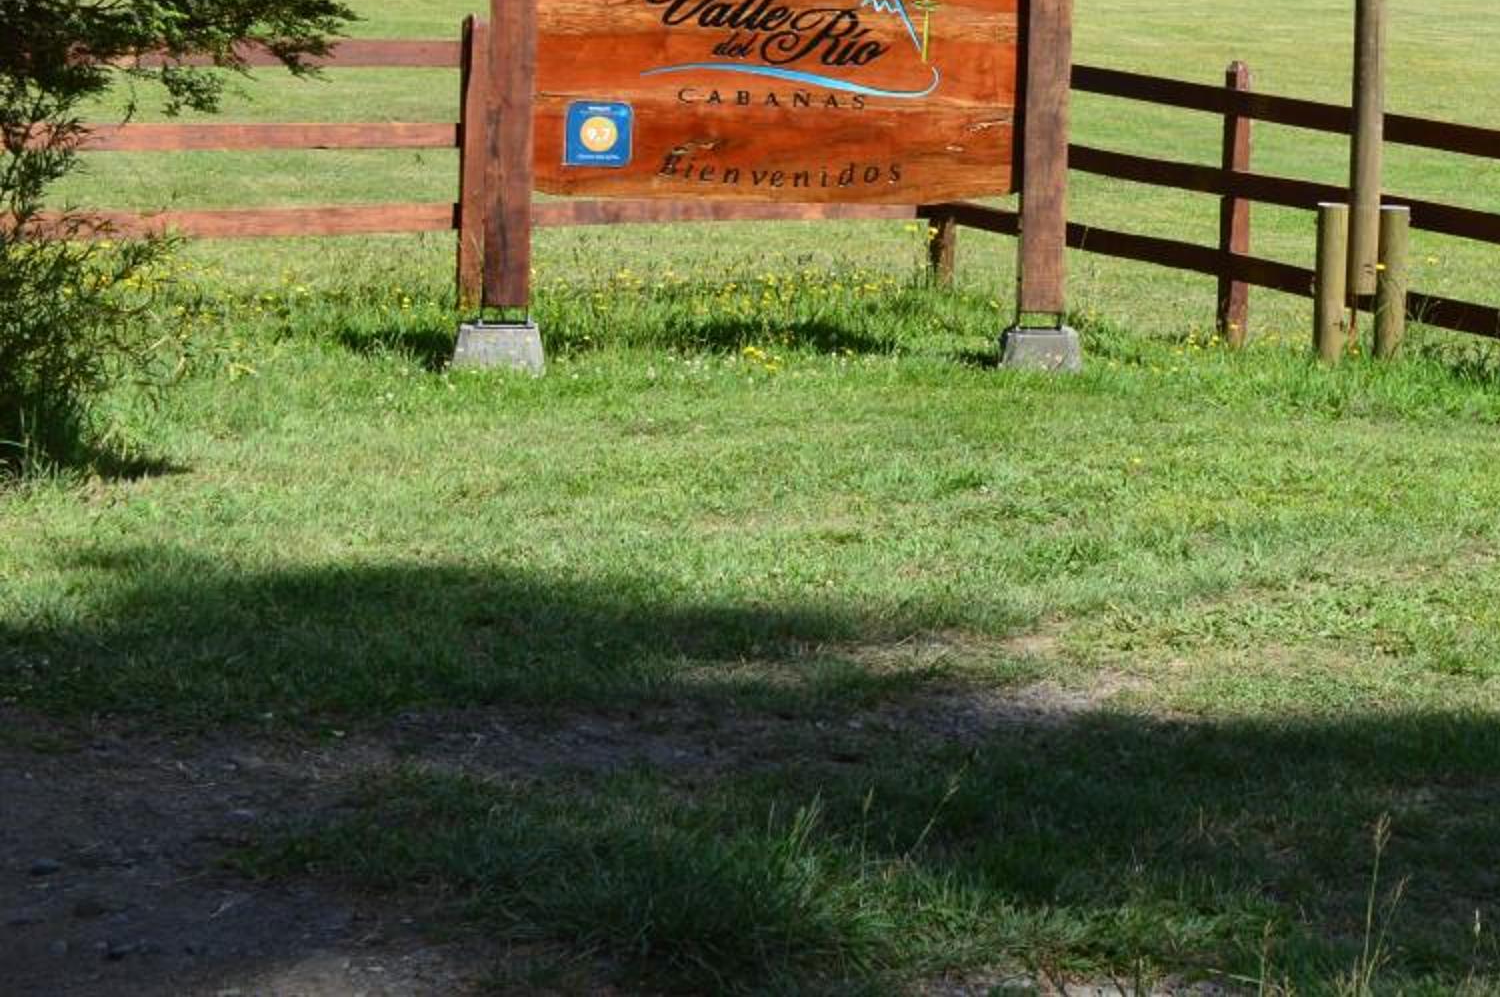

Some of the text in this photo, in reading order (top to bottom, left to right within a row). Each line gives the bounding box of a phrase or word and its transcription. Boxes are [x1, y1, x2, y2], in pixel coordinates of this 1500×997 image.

[711, 8, 890, 66] del Río
[677, 87, 866, 110] CABAÑAS
[658, 152, 902, 188] Bienvenidos
